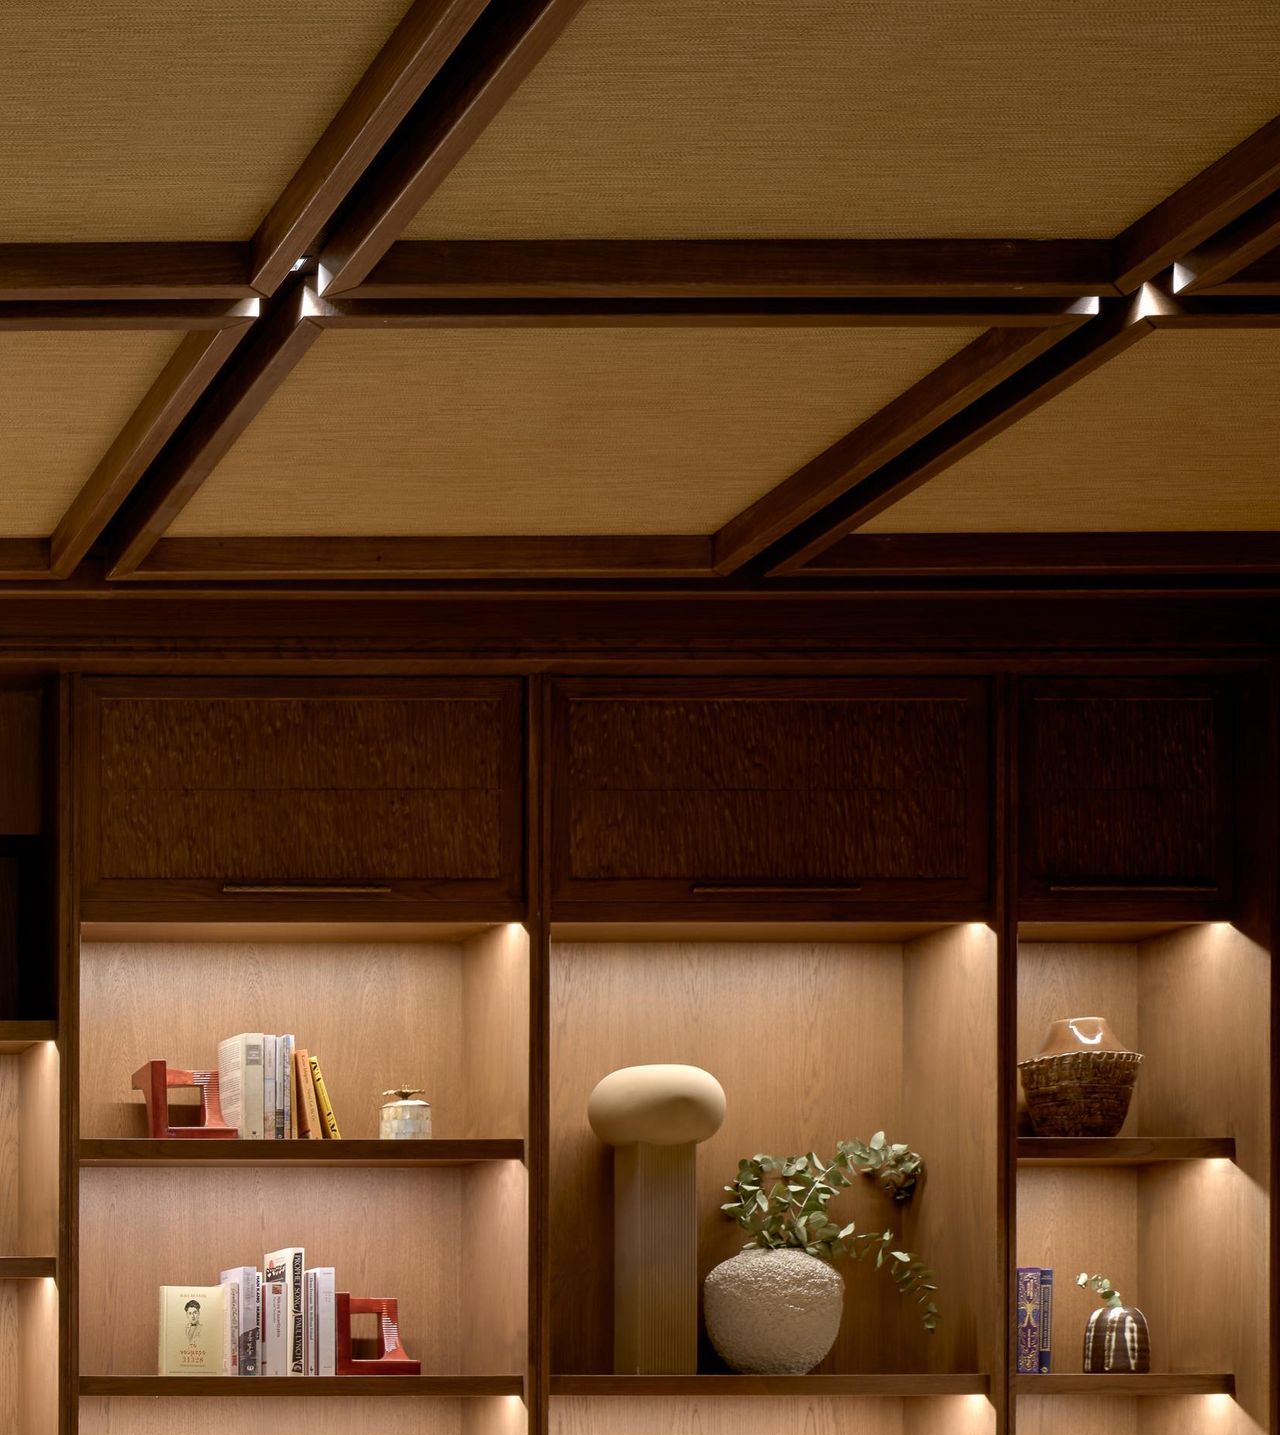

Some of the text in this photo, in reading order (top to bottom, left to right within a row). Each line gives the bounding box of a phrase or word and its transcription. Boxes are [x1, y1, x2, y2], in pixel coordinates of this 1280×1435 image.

[293, 1254, 302, 1309] PROPHET SONG
[295, 1316, 303, 1360] PAUL LYNCH
